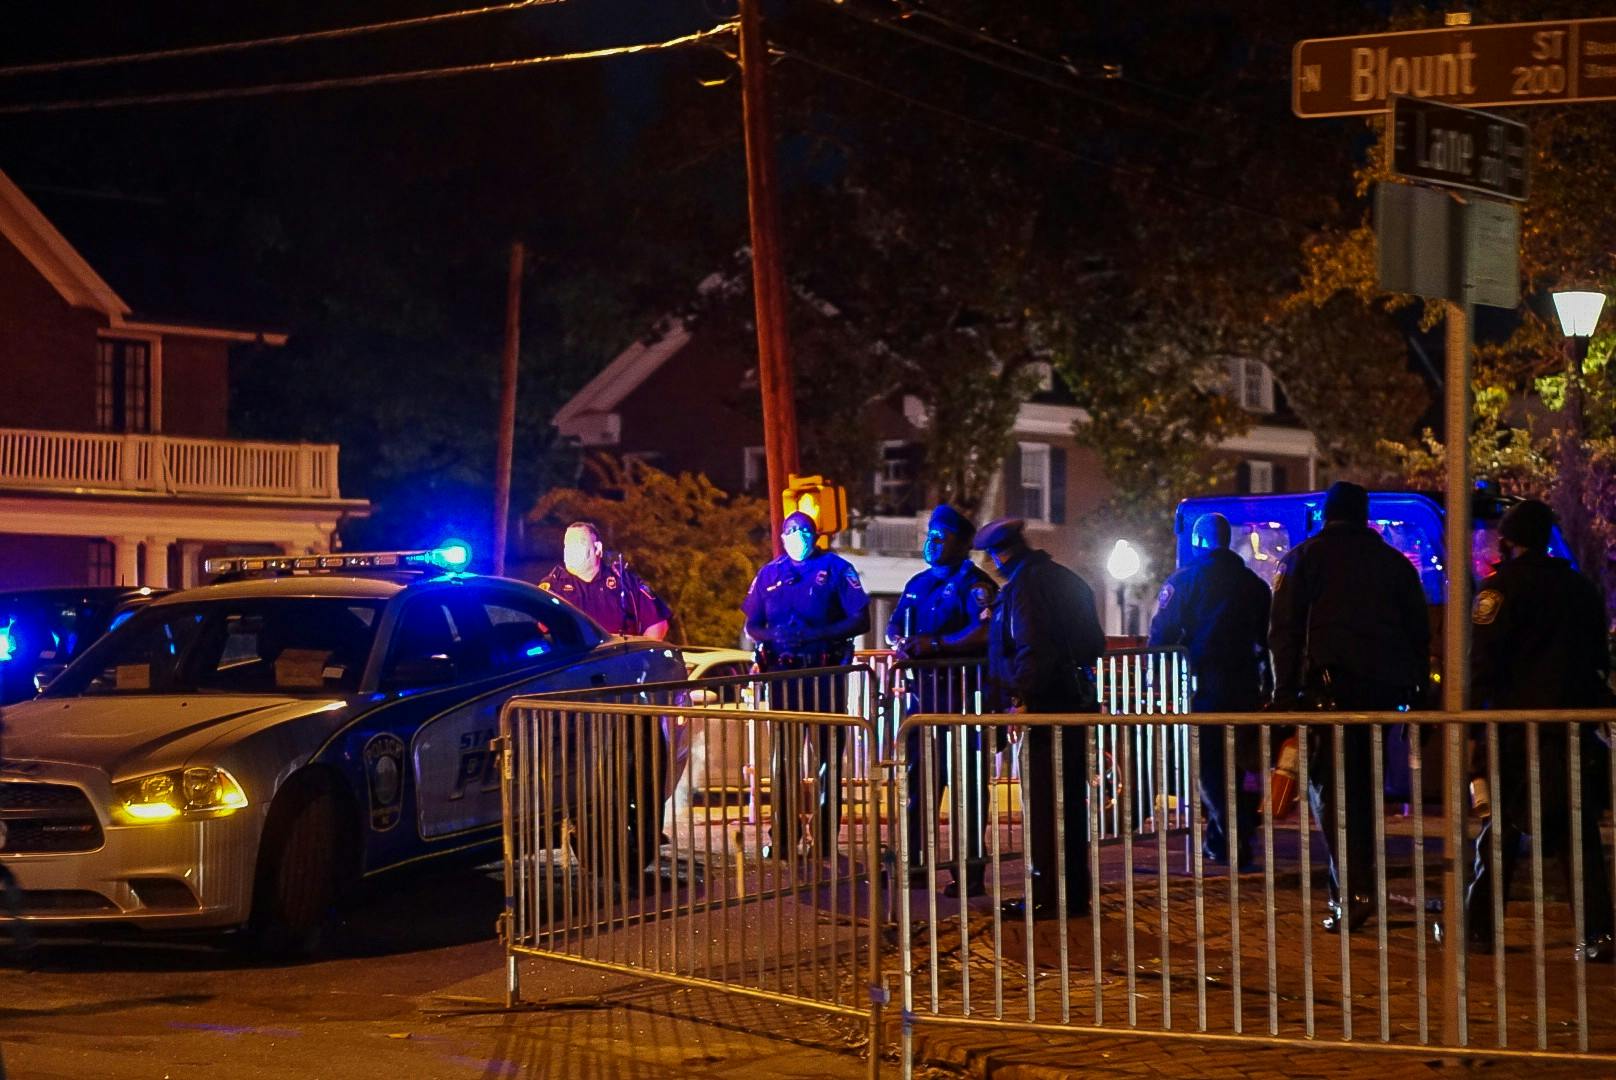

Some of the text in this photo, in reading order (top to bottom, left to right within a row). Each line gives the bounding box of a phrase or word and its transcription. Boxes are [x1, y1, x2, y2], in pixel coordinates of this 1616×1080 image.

[1302, 64, 1322, 93] N
[1351, 41, 1477, 102] Blount
[1532, 30, 1566, 60] ST
[1511, 64, 1566, 95] 200
[1416, 109, 1474, 176] Lane
